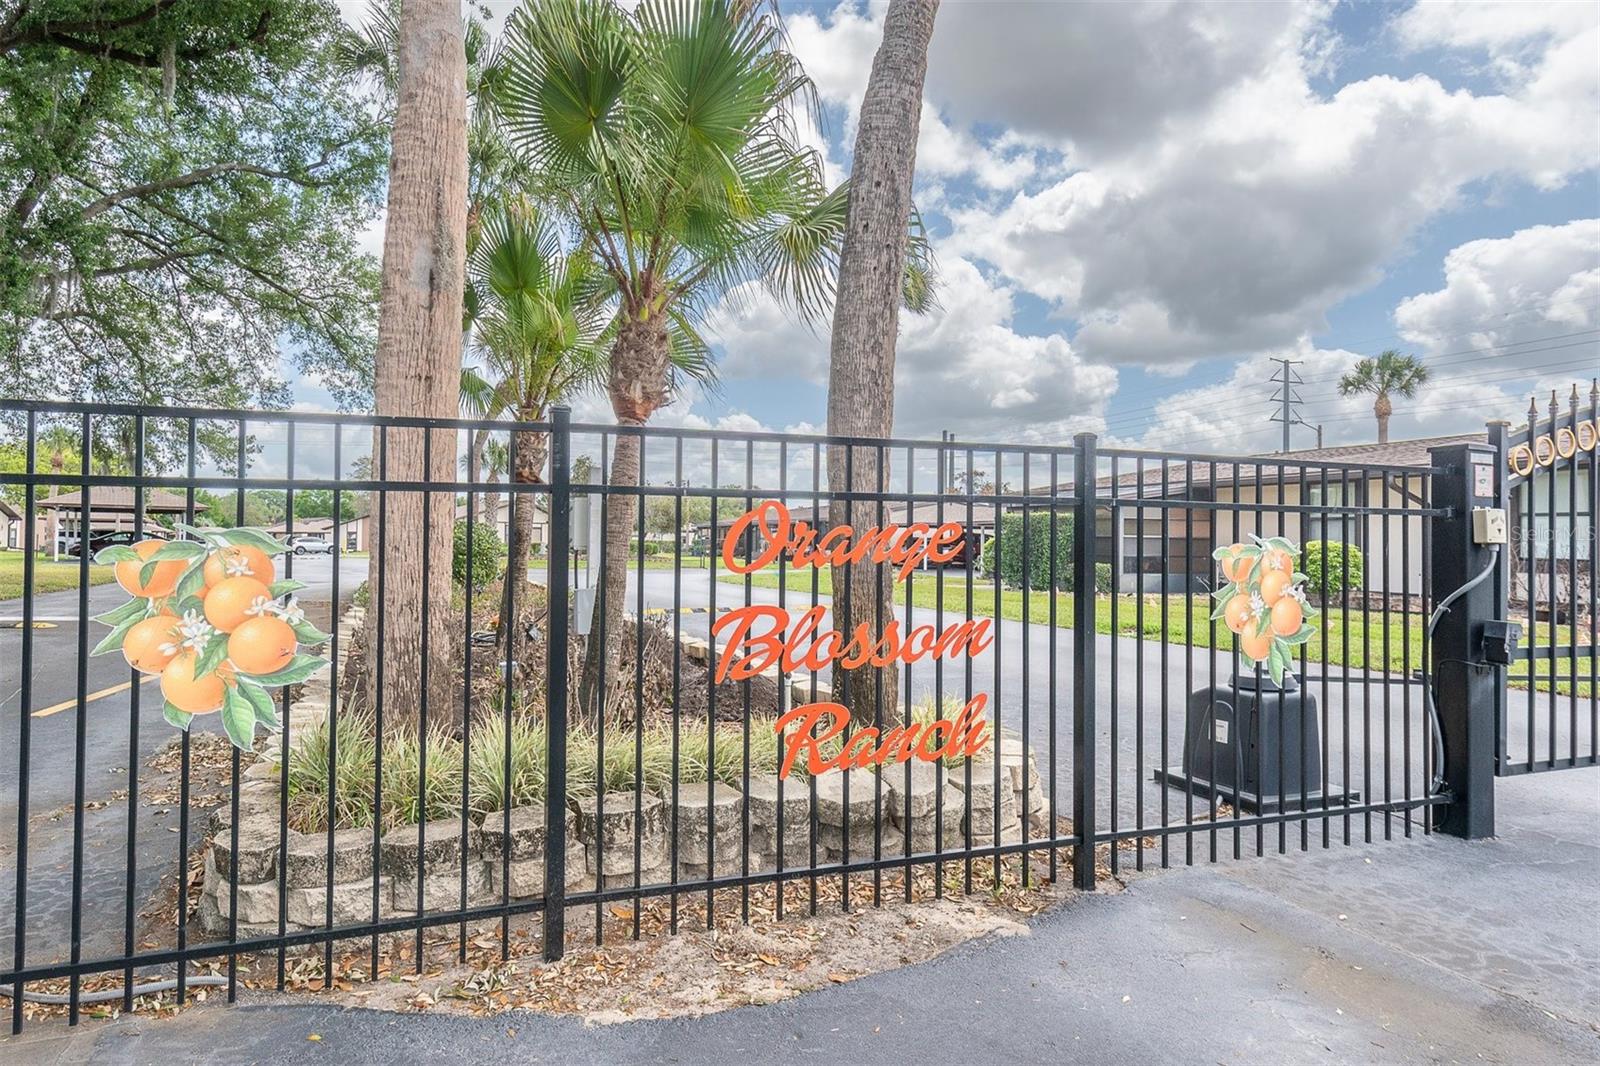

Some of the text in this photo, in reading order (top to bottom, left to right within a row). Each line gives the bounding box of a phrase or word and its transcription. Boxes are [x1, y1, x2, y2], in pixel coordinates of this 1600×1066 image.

[722, 500, 965, 582] Orange
[711, 605, 993, 685] Blossom
[774, 692, 990, 780] Ranch
